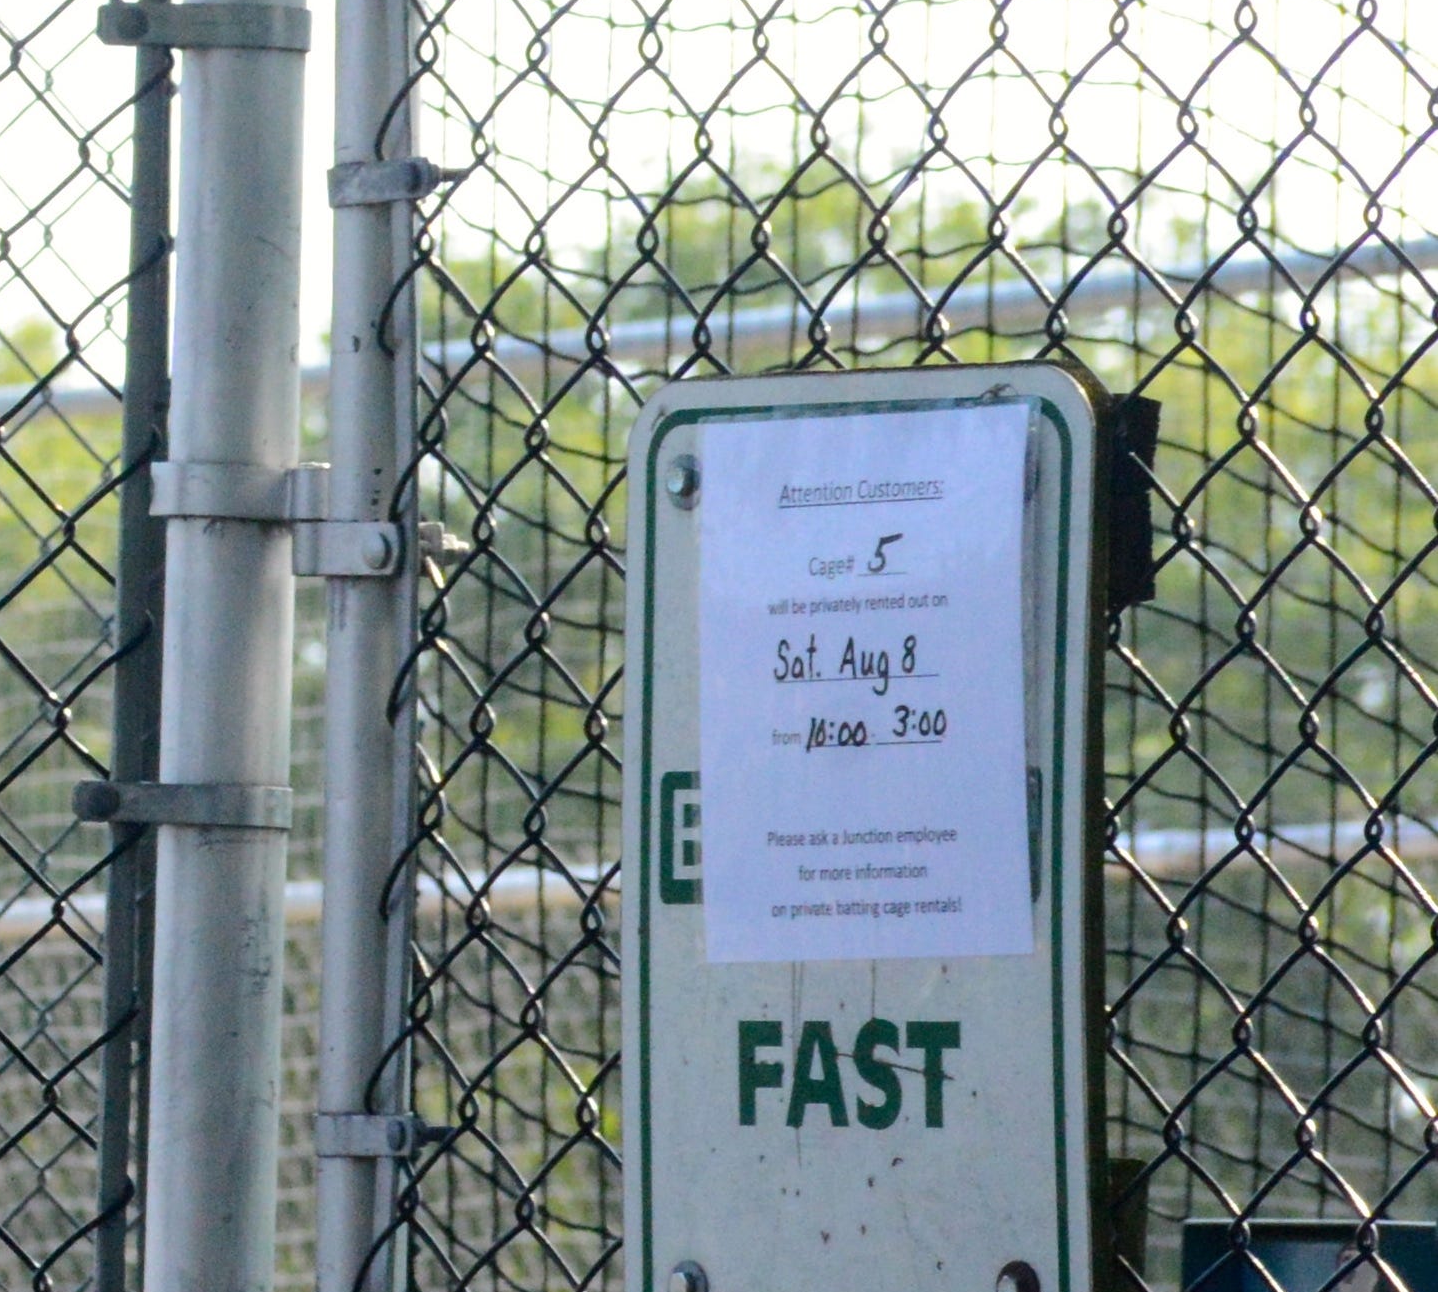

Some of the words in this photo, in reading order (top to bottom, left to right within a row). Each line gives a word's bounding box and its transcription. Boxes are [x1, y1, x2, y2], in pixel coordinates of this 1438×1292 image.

[779, 482, 853, 505] Attention
[857, 478, 944, 501] Customers:
[809, 554, 855, 579] Cage#
[866, 532, 904, 573] 5
[768, 599, 790, 616] will
[792, 599, 806, 615] be
[810, 596, 862, 618] privately
[865, 595, 905, 609] rented
[909, 595, 929, 608] out
[932, 595, 948, 607] on
[839, 636, 890, 695] Aug
[901, 635, 918, 673] 8
[772, 729, 801, 746] from
[892, 705, 947, 737] 3:00
[767, 831, 805, 846] Please
[809, 831, 828, 845] ask
[831, 834, 839, 845] a
[841, 829, 893, 846] Junction
[896, 828, 958, 846] employee
[799, 865, 816, 881] for
[819, 868, 852, 880] more
[855, 865, 927, 879] information
[771, 906, 788, 918] on
[791, 904, 832, 919] private
[836, 903, 879, 918] batting
[883, 902, 911, 918] cage
[915, 898, 962, 914] rentals!
[737, 1017, 962, 1131] FAST
